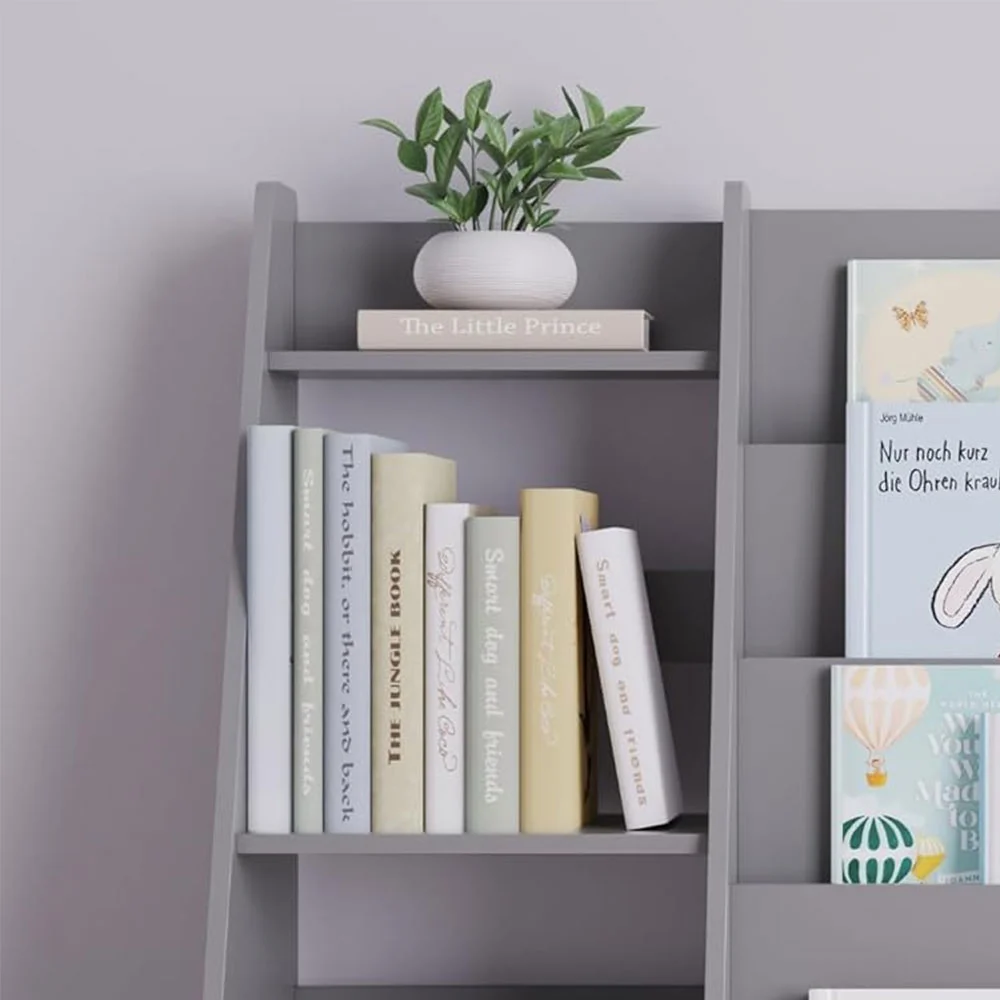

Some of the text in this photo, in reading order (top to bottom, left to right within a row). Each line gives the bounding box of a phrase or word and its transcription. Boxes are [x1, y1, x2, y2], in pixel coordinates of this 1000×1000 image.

[400, 317, 602, 336] The Little Prince
[341, 443, 354, 492] The
[879, 440, 988, 463] Nur noch kurz
[878, 470, 902, 493] die
[908, 468, 958, 493] Ohren
[341, 598, 353, 625] or
[596, 557, 616, 618] Smart
[341, 633, 354, 694] there
[388, 550, 401, 765] THE JUNGLE BOOK
[481, 547, 505, 804] Smart dog and friends
[340, 703, 353, 754] and
[341, 762, 354, 822] back
